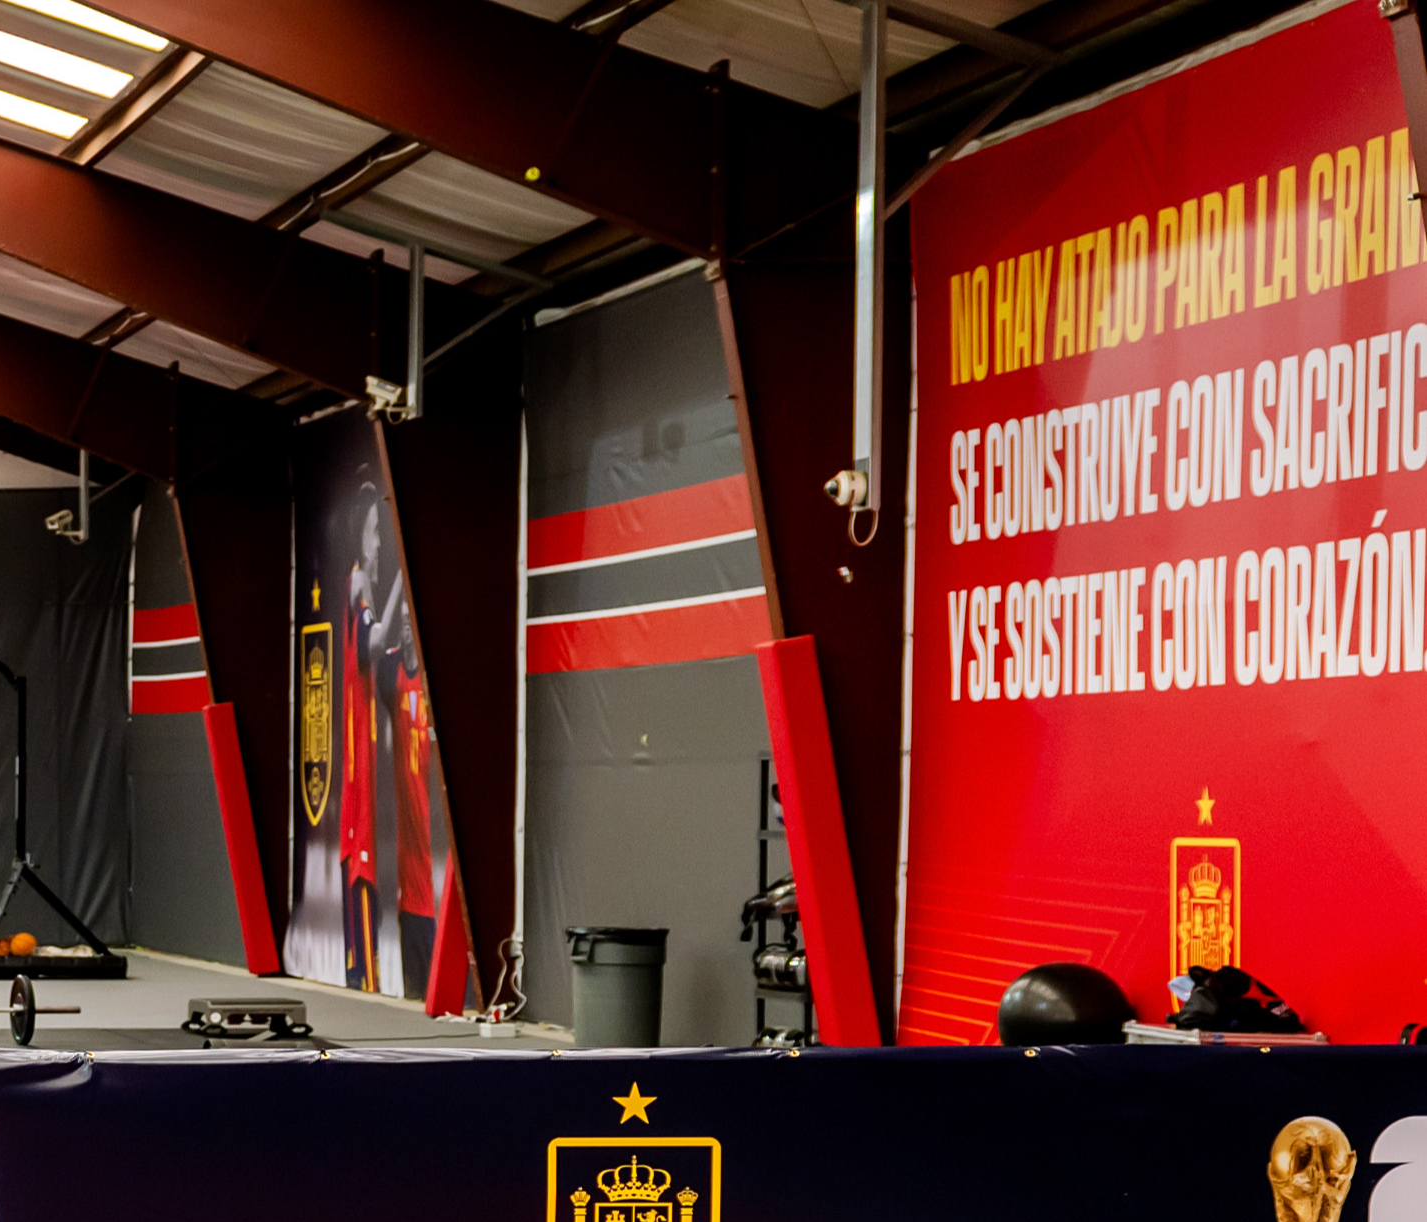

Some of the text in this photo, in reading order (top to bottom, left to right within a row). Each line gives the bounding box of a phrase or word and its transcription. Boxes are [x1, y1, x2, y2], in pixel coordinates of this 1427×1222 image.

[950, 126, 1427, 386] NO HAY ATAJO PARA LA GRAN
[949, 427, 981, 545] SE
[984, 387, 1160, 542] CONSTRUYE
[1165, 366, 1246, 512] CON
[948, 589, 968, 702] Y
[968, 585, 1001, 702] SE
[1003, 565, 1146, 701] SOSTIENE
[1151, 555, 1228, 692] CON
